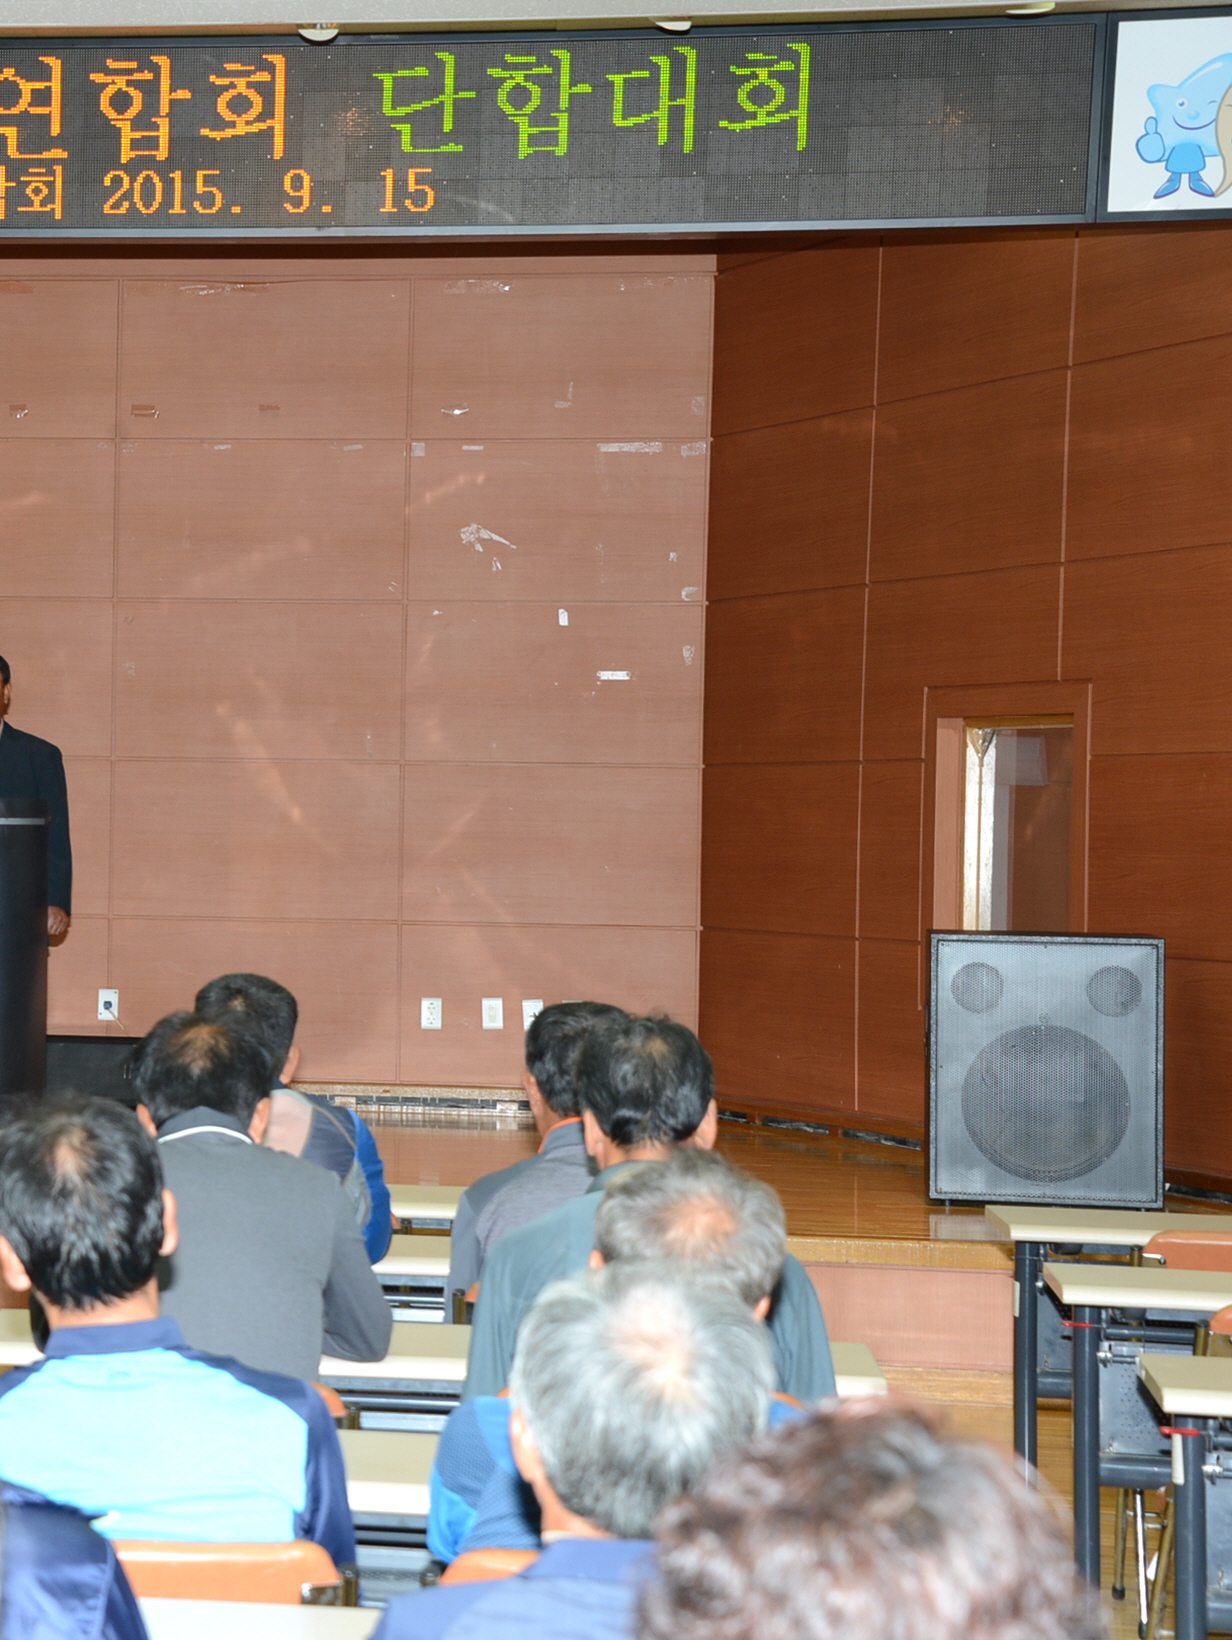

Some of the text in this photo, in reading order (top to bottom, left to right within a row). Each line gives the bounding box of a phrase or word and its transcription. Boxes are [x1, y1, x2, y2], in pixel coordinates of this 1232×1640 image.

[373, 43, 810, 159] 단합대회
[103, 169, 243, 214] 2015.
[283, 168, 333, 213] 9.
[379, 167, 436, 212] 15
